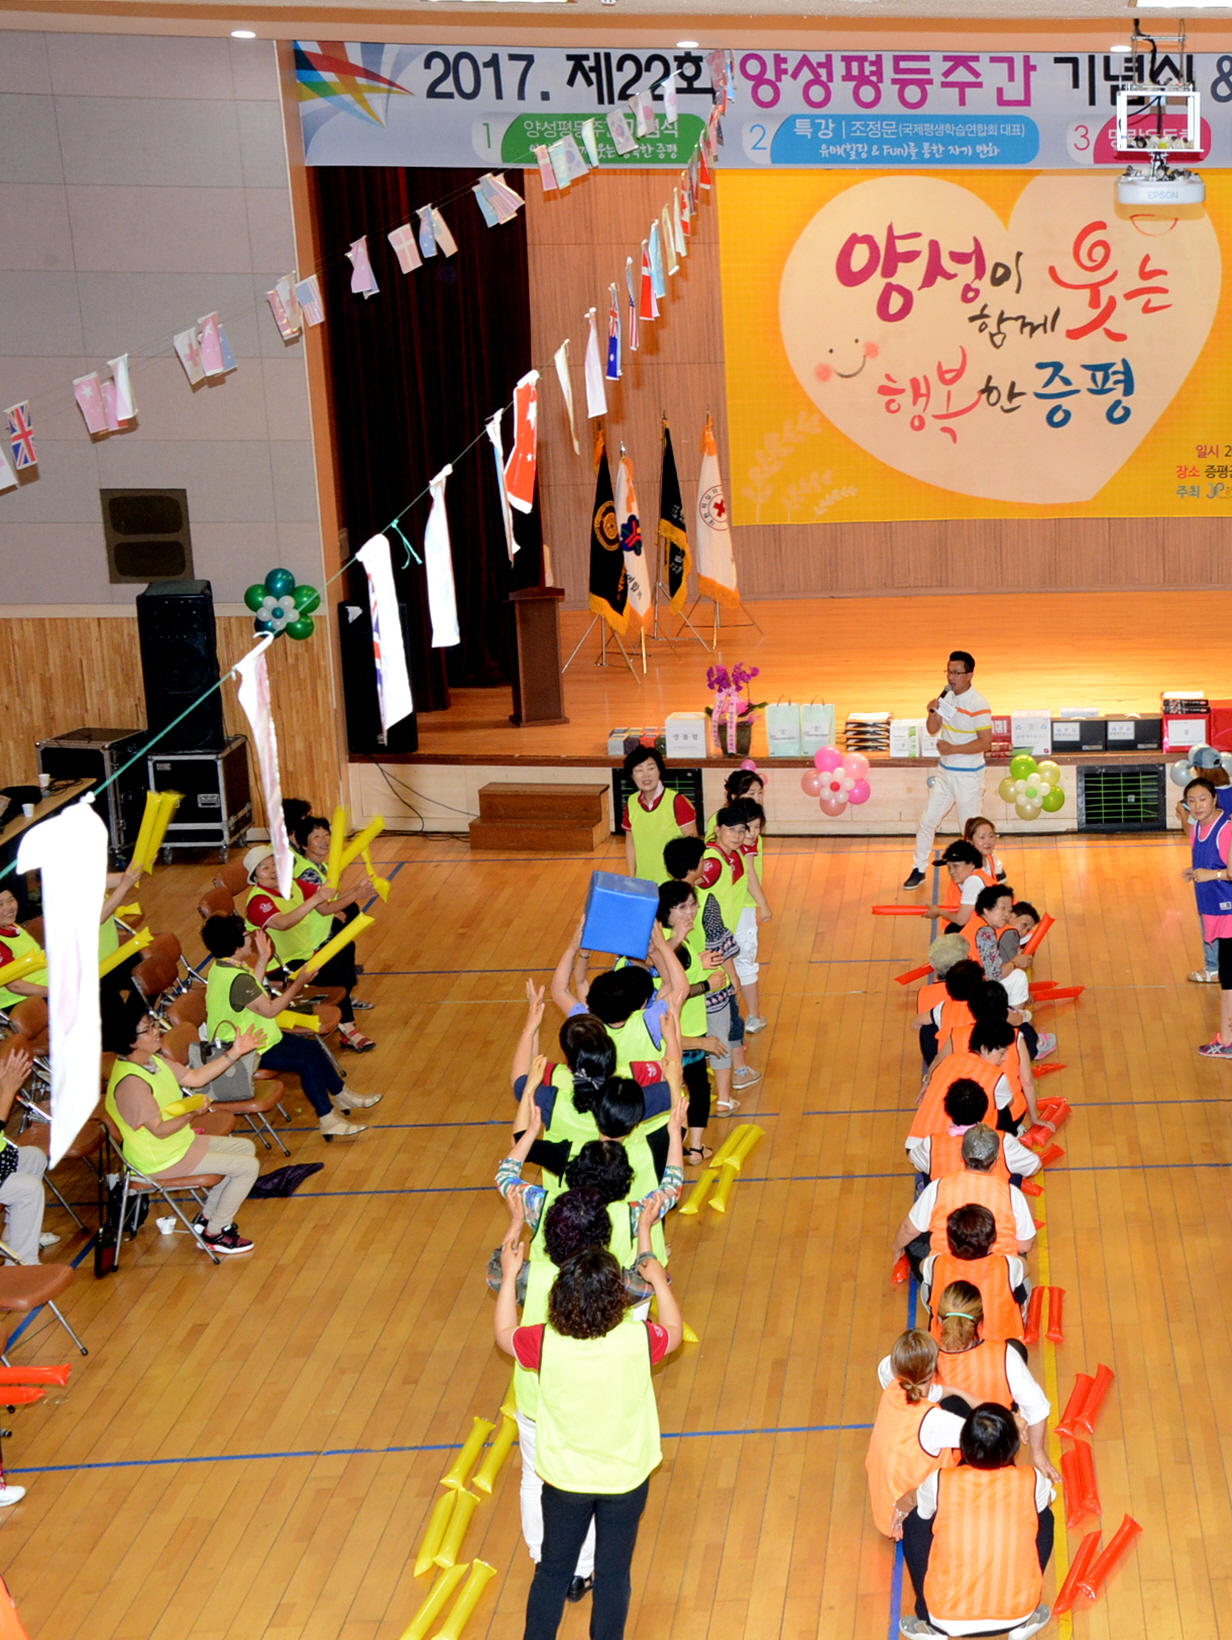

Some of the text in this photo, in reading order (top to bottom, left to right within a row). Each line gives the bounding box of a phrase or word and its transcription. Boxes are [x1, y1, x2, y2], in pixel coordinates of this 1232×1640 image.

[423, 51, 551, 102] 2017.
[566, 51, 716, 106] 제22회
[739, 53, 1037, 108] 양성평등주간
[482, 122, 492, 149] 1
[749, 123, 768, 151] 2
[793, 118, 836, 140] 특강
[1000, 123, 1026, 138] 대표)
[1073, 124, 1091, 151] 3
[921, 143, 945, 159] 통한
[947, 146, 973, 156] 자기
[975, 142, 1001, 159] 변화
[1147, 191, 1179, 200] EPSON
[835, 220, 1173, 349] 양성이 함께 웃는
[877, 345, 1135, 444] 행복한 증평
[1195, 445, 1220, 459] 일시
[1176, 465, 1201, 479] 장소
[1176, 485, 1201, 499] 주최
